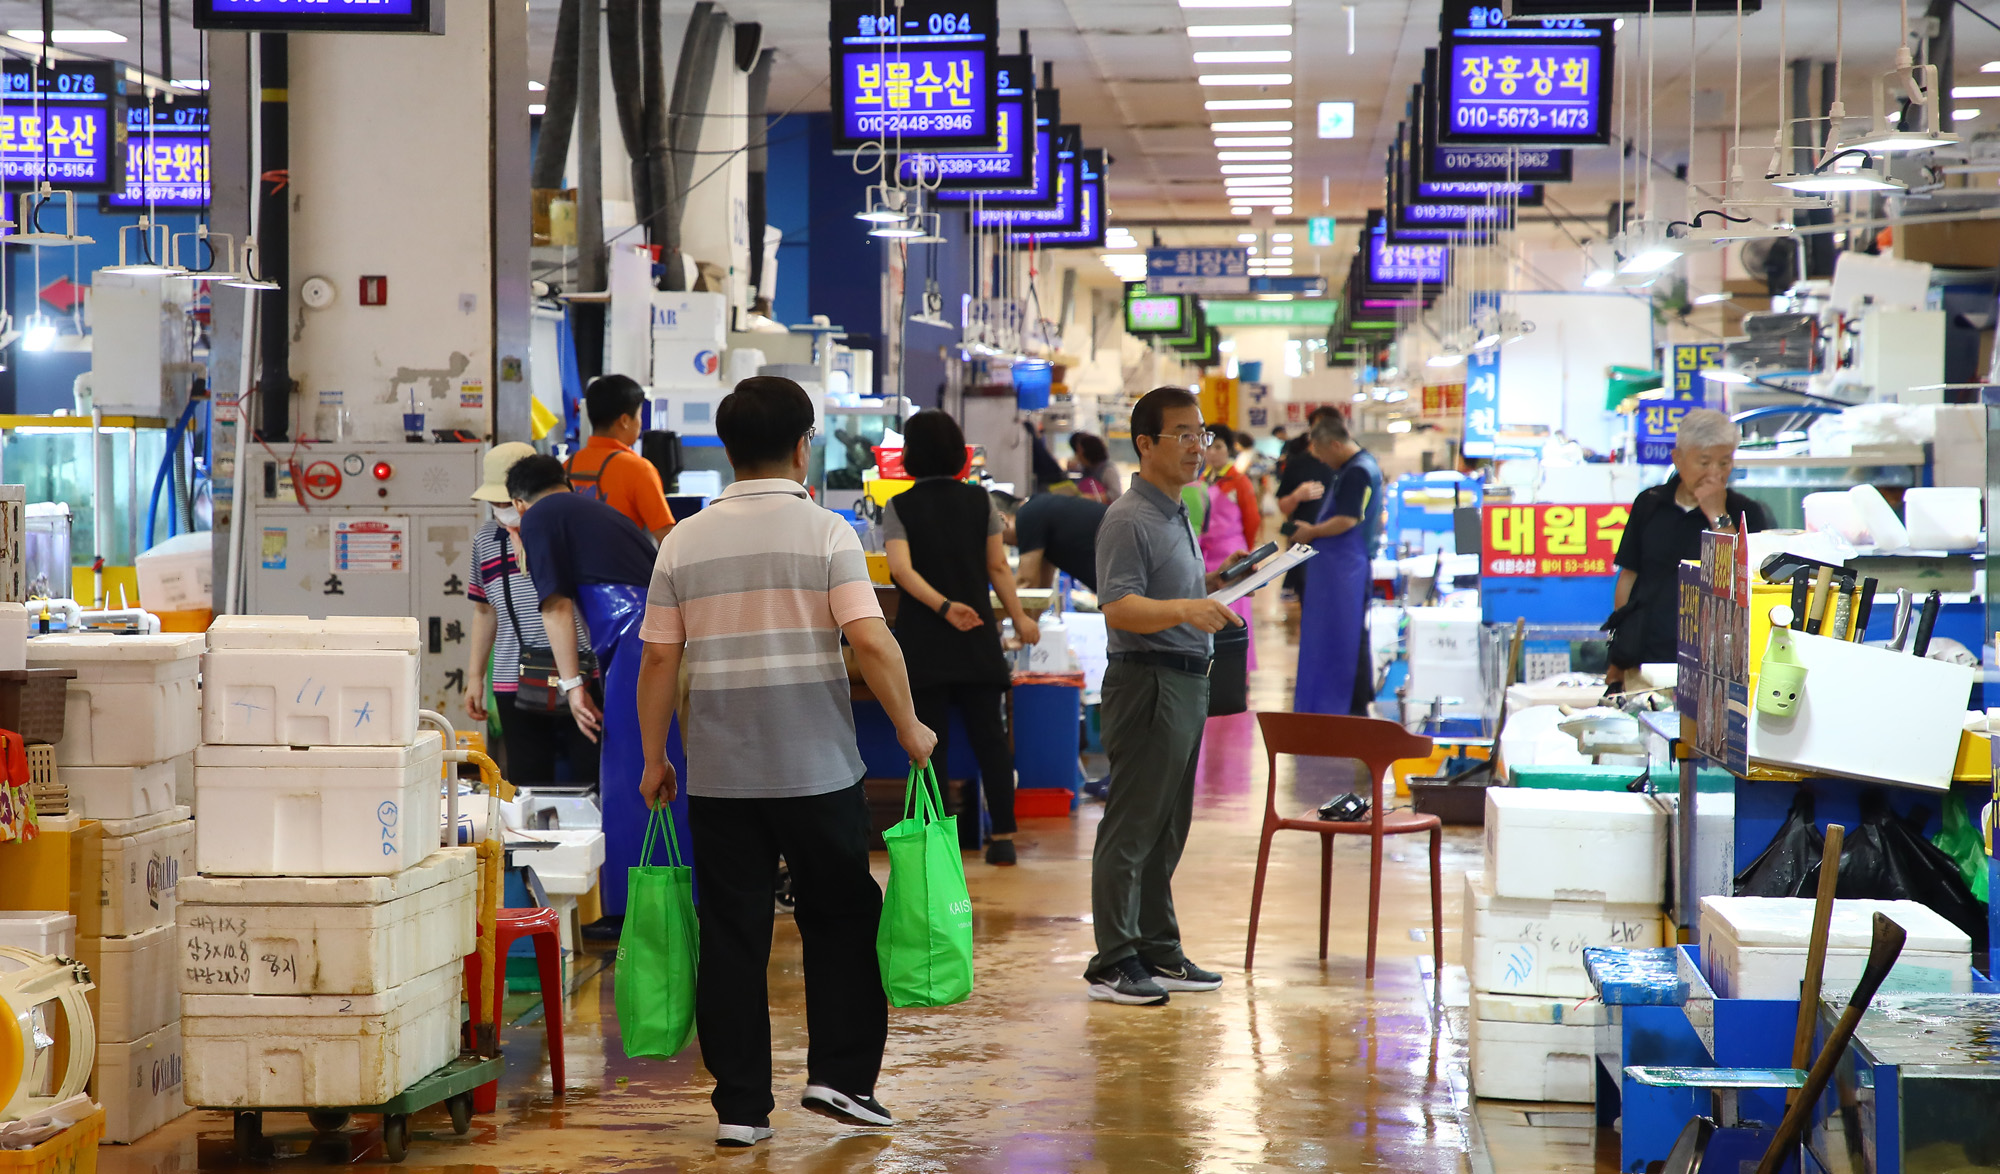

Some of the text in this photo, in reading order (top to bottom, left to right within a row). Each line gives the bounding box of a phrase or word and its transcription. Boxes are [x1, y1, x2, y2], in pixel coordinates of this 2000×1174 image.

[858, 14, 895, 35] 활어
[928, 13, 971, 34] 064
[57, 74, 95, 93] 078
[855, 60, 974, 109] 보물수산
[1461, 57, 1590, 96] 장흥상회
[858, 114, 972, 132] 010-2448-3946
[1457, 106, 1589, 129] 010-5673-1473
[1175, 250, 1245, 276] 화장실
[339, 1000, 352, 1012] 2
